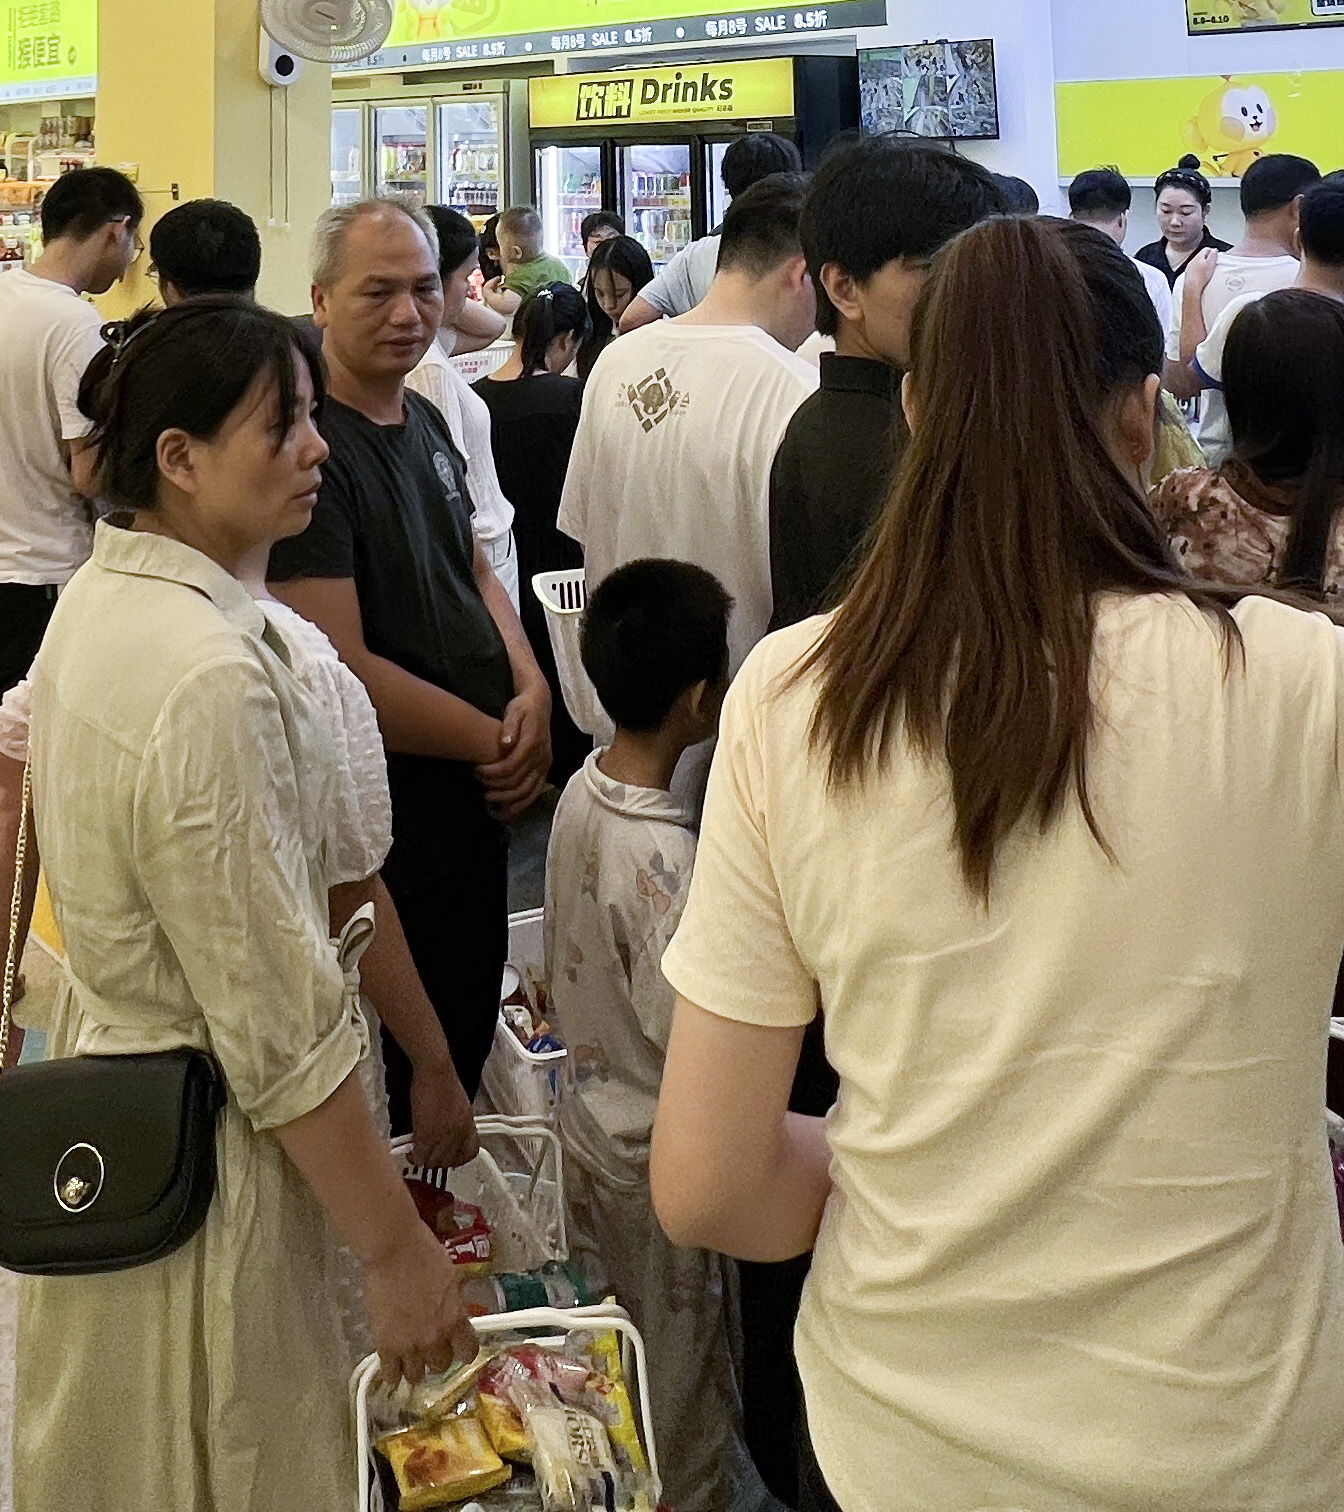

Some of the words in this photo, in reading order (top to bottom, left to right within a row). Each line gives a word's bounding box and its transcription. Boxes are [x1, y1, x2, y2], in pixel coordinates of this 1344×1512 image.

[706, 17, 747, 38] 每月8号
[755, 15, 786, 31] SALE
[793, 10, 828, 29] 8.5折
[456, 45, 478, 59] SALE
[551, 33, 585, 50] 每月8号
[591, 31, 618, 46] SALE
[578, 80, 633, 119] 饮料
[640, 72, 733, 105] Drinks
